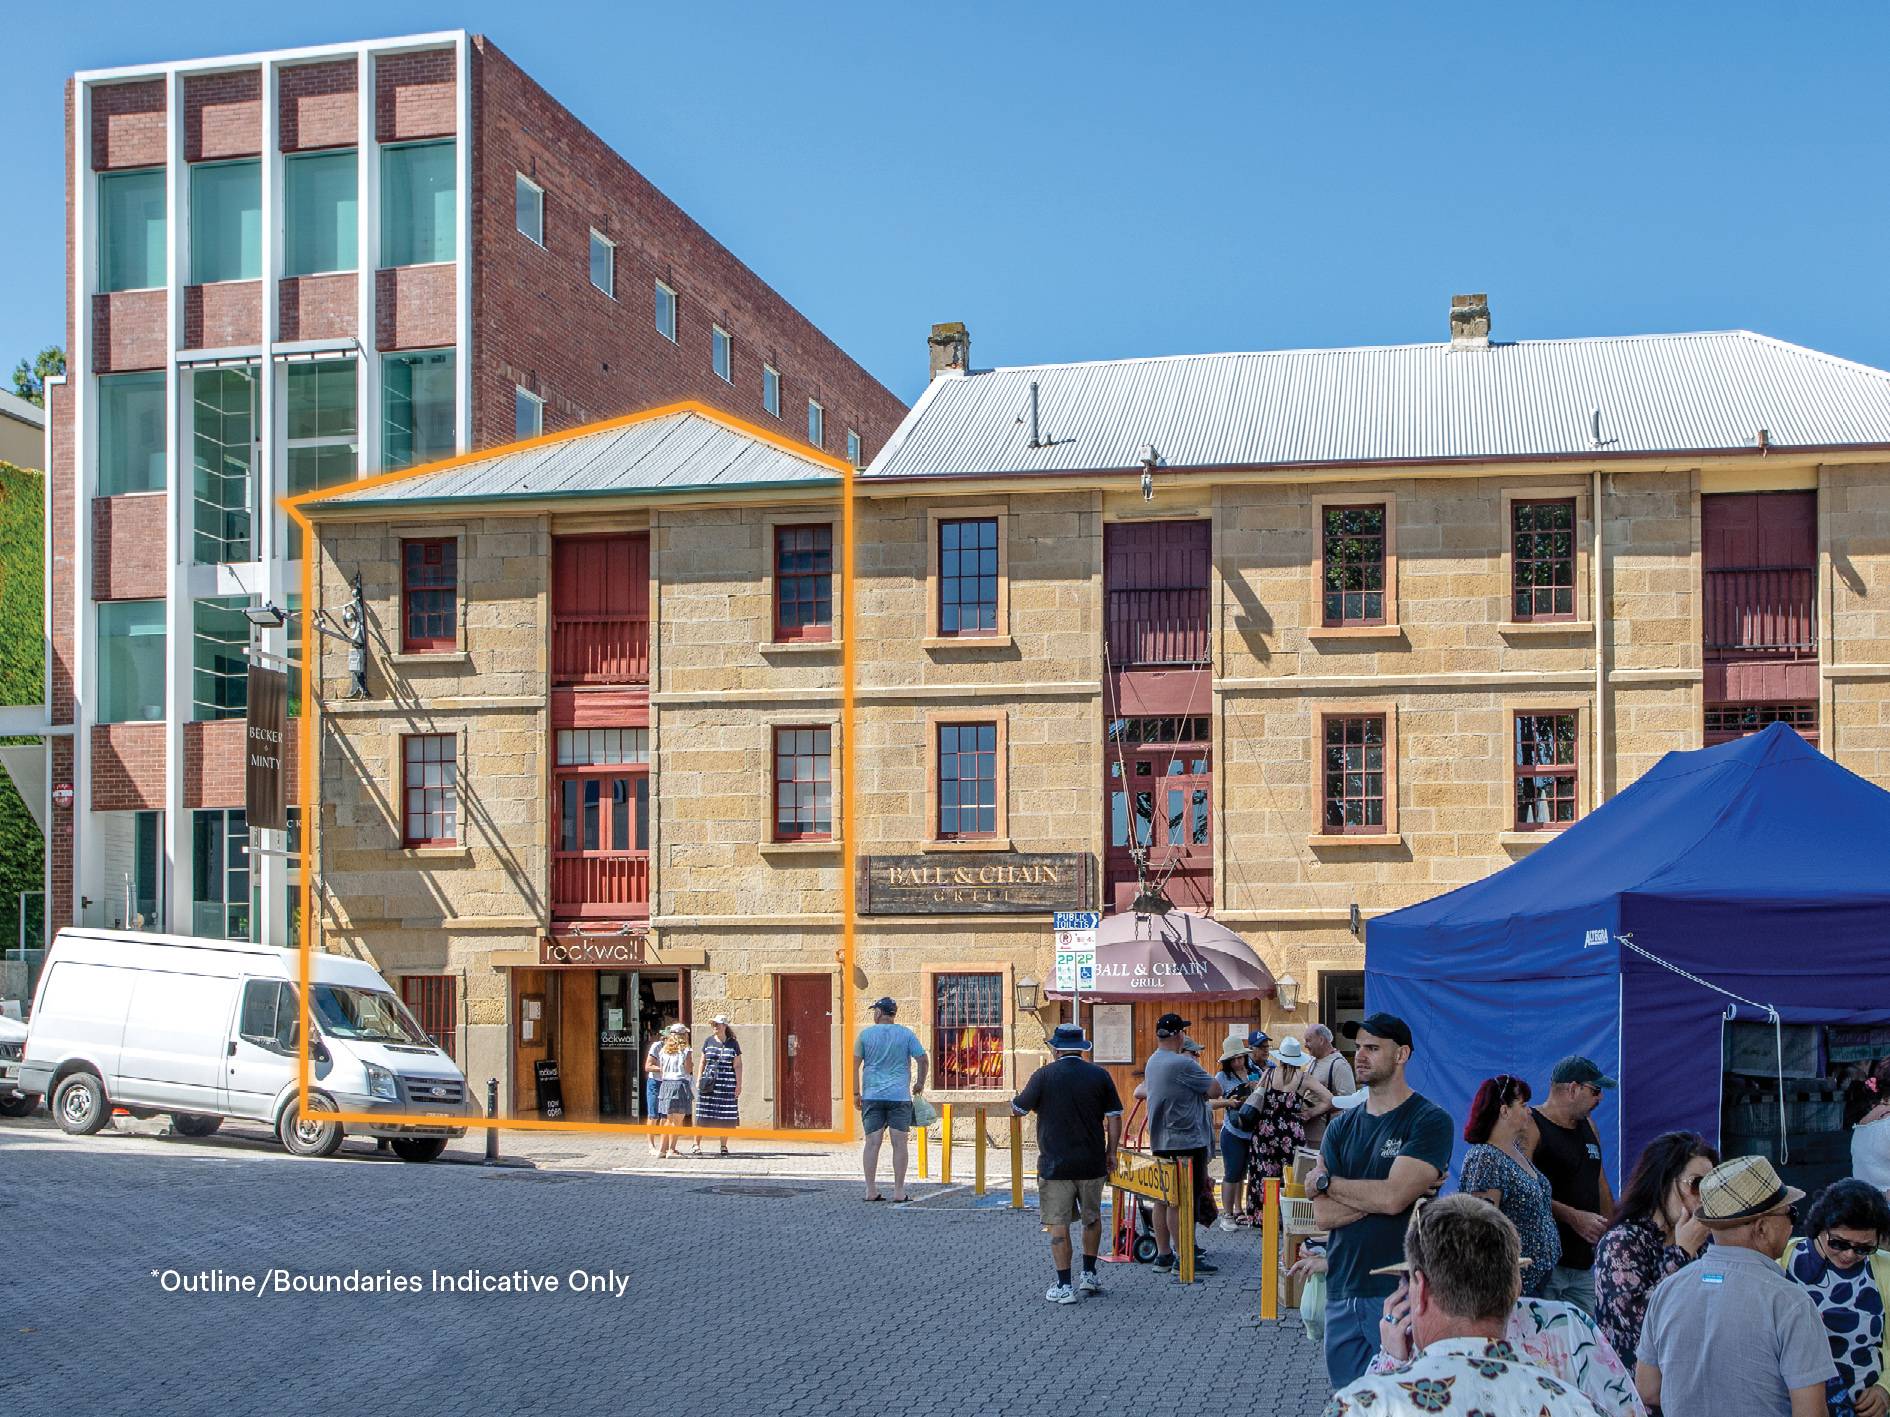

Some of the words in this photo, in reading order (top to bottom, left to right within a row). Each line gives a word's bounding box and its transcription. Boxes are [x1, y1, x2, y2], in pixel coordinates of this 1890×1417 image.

[249, 726, 283, 743] BECKER
[251, 753, 281, 770] MINTY
[889, 867, 948, 884] BALL
[953, 866, 973, 884] &
[979, 865, 1058, 884] CHAIN
[934, 890, 1010, 902] GRILL
[1057, 913, 1088, 921] PUBLIC
[1056, 920, 1089, 928] TOILETS
[546, 939, 638, 961] rockwall
[1057, 954, 1074, 965] 2P
[1077, 953, 1094, 965] 2P
[1095, 963, 1130, 977] BALL
[1134, 963, 1148, 976] &
[1152, 961, 1208, 976] CHAIN
[1130, 978, 1165, 988] GRILL
